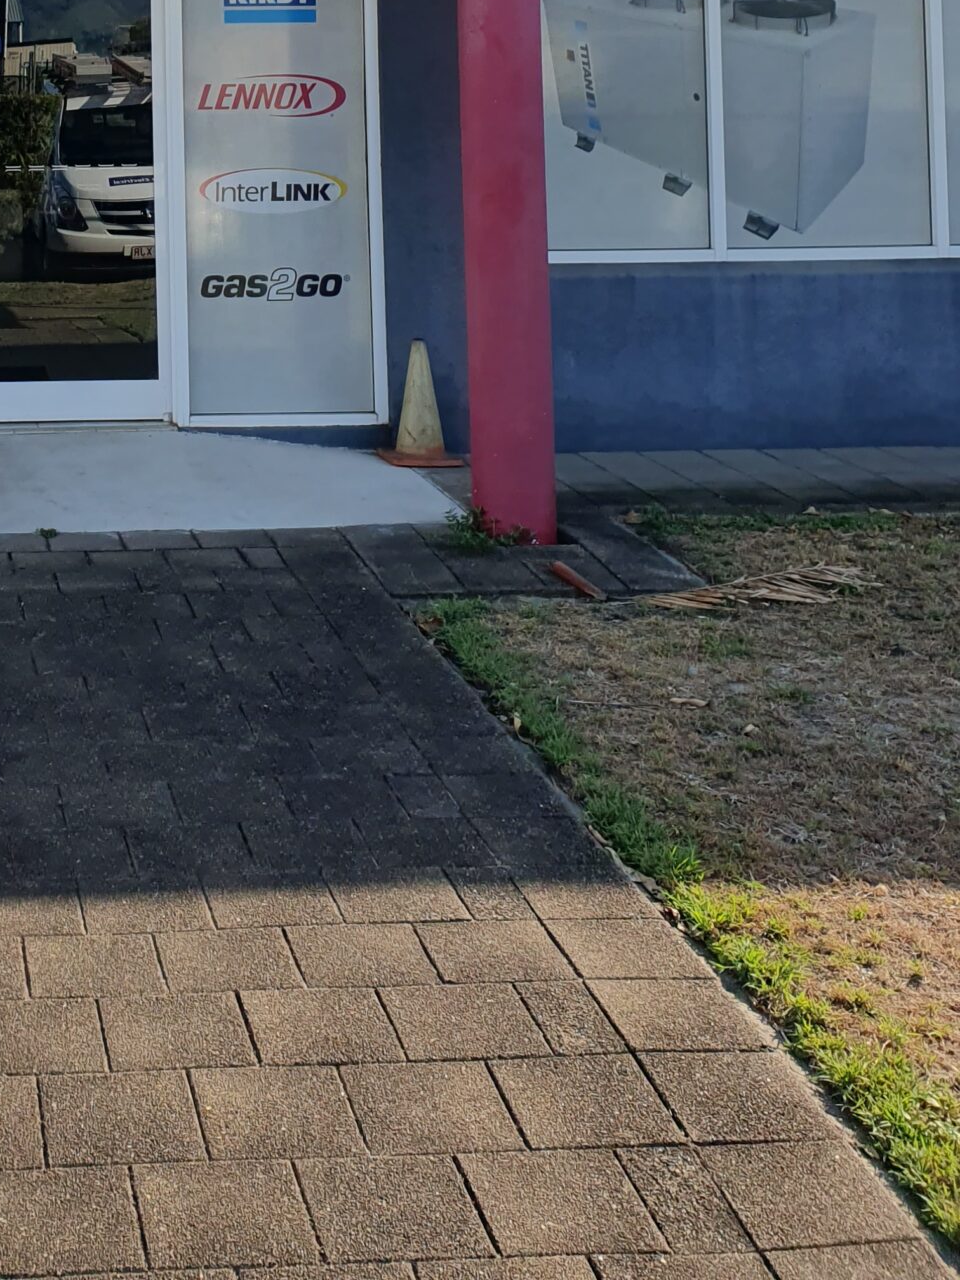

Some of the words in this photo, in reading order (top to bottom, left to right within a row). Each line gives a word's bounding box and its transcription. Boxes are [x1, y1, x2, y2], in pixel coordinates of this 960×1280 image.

[580, 43, 594, 90] TITAN
[198, 83, 317, 110] LENNOX
[216, 181, 332, 202] InterLINK
